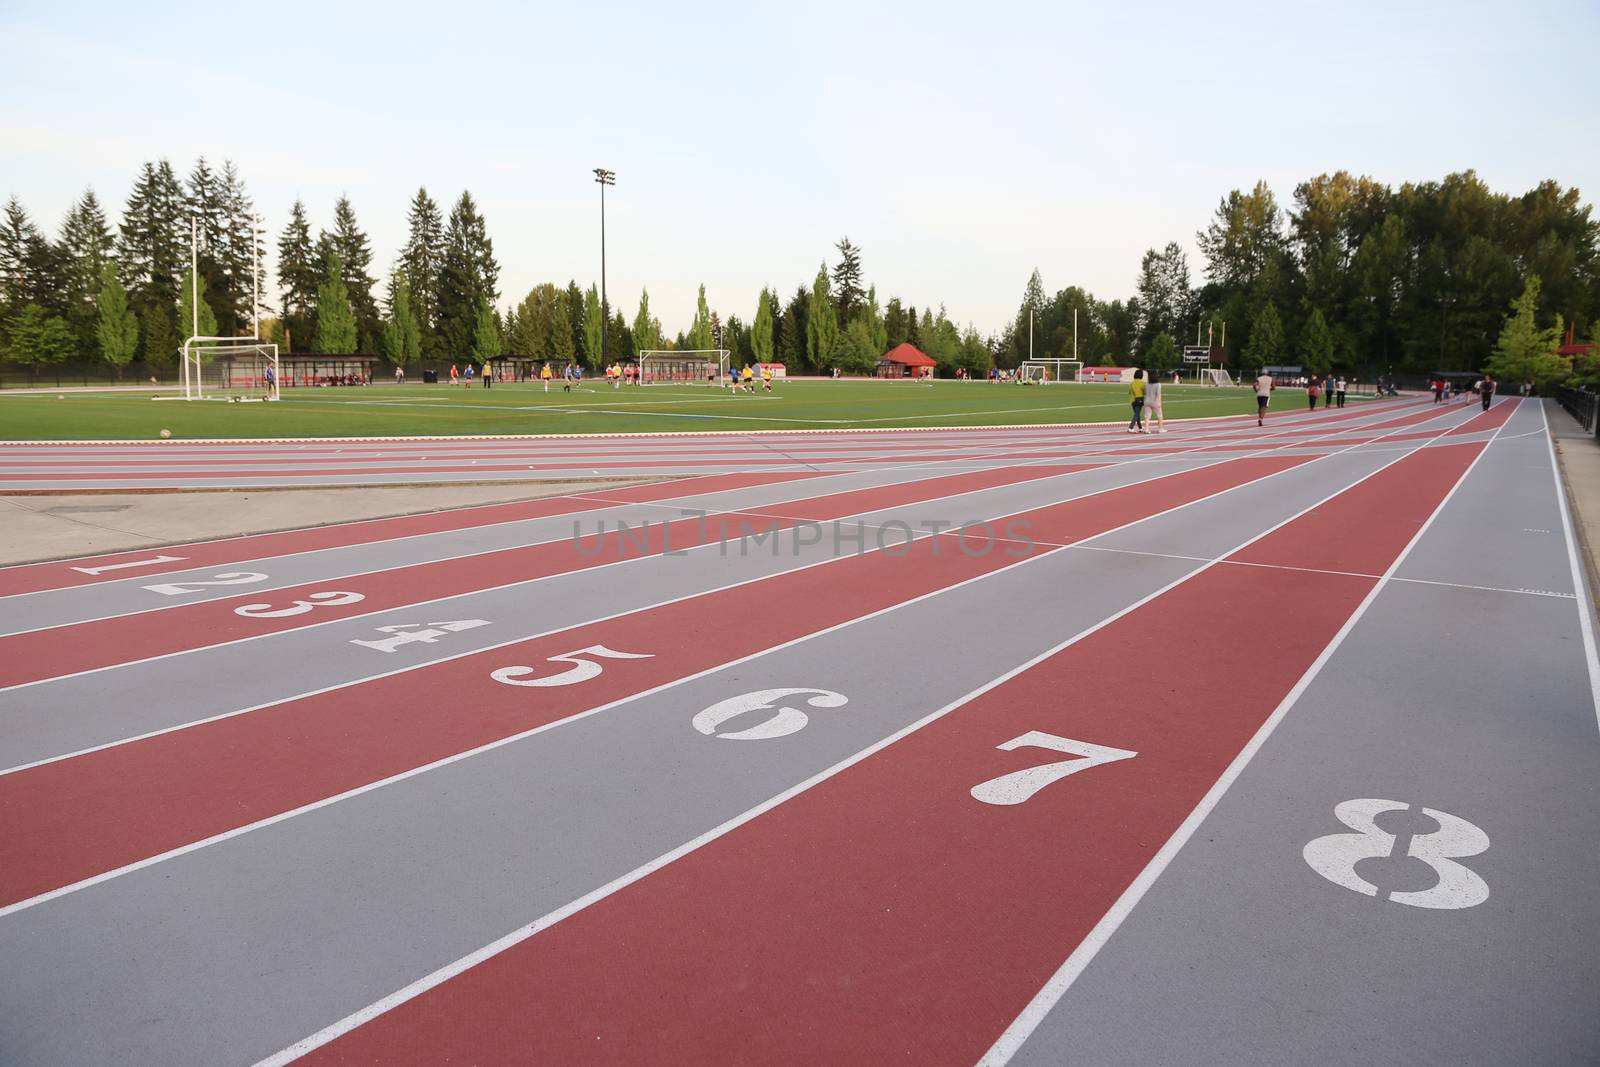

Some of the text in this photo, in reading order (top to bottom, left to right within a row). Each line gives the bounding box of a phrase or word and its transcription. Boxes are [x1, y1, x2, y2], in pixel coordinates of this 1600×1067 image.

[71, 555, 189, 576] 1
[141, 571, 270, 596] 2
[234, 591, 366, 618] 3
[349, 618, 492, 654] 4
[491, 645, 655, 688] 5
[692, 687, 848, 741] 6
[970, 730, 1138, 806] 7
[1302, 798, 1491, 910] 8
